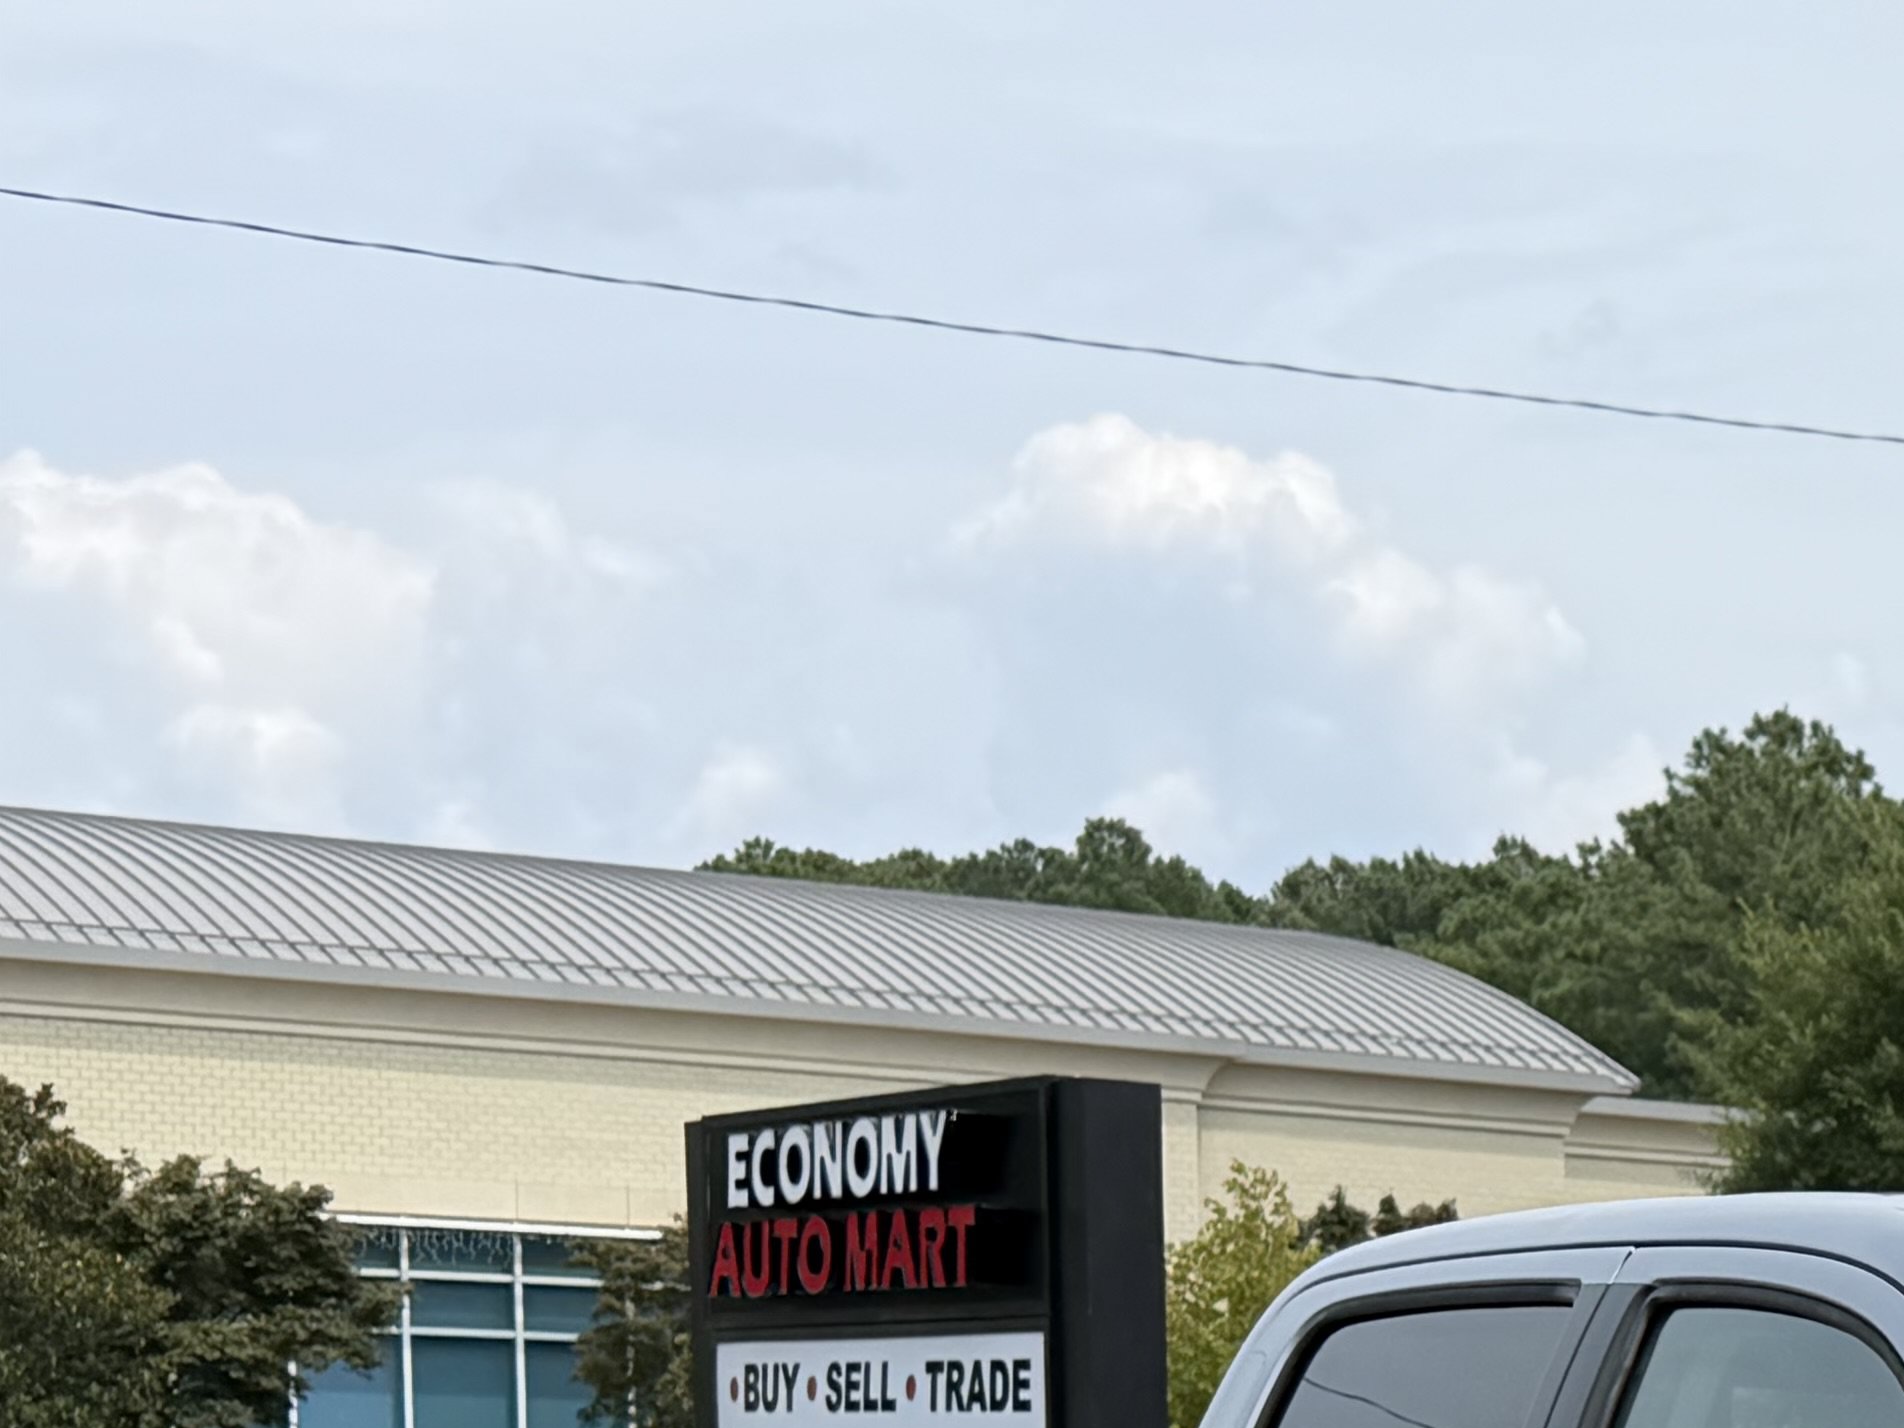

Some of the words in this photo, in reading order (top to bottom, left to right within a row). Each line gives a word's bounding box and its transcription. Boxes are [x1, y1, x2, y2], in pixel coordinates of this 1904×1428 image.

[727, 1110, 947, 1209] ECONOMY
[709, 1215, 831, 1298] AUTO
[843, 1204, 975, 1292] MART
[744, 1361, 801, 1413] BUY
[825, 1360, 897, 1413] SELL
[925, 1358, 1032, 1413] TRADE
